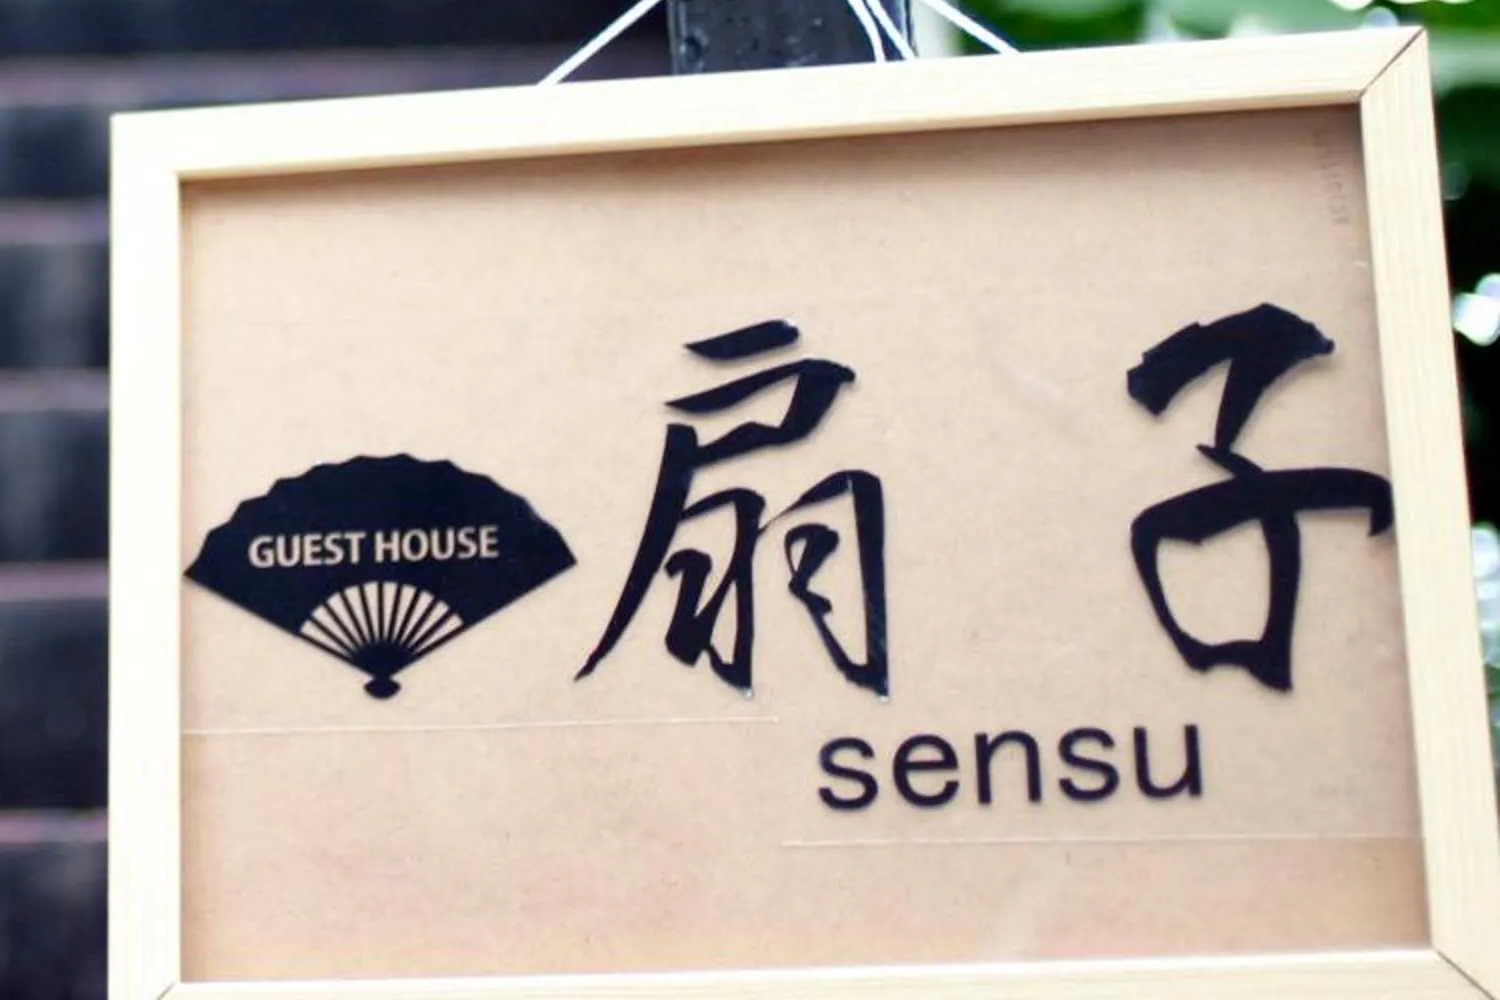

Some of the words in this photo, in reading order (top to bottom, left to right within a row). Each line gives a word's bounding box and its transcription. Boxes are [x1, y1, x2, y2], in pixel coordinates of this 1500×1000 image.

[574, 302, 1394, 696] 扇子
[247, 530, 367, 569] GUEST
[373, 525, 499, 564] HOUSE
[817, 722, 1203, 811] sensu
